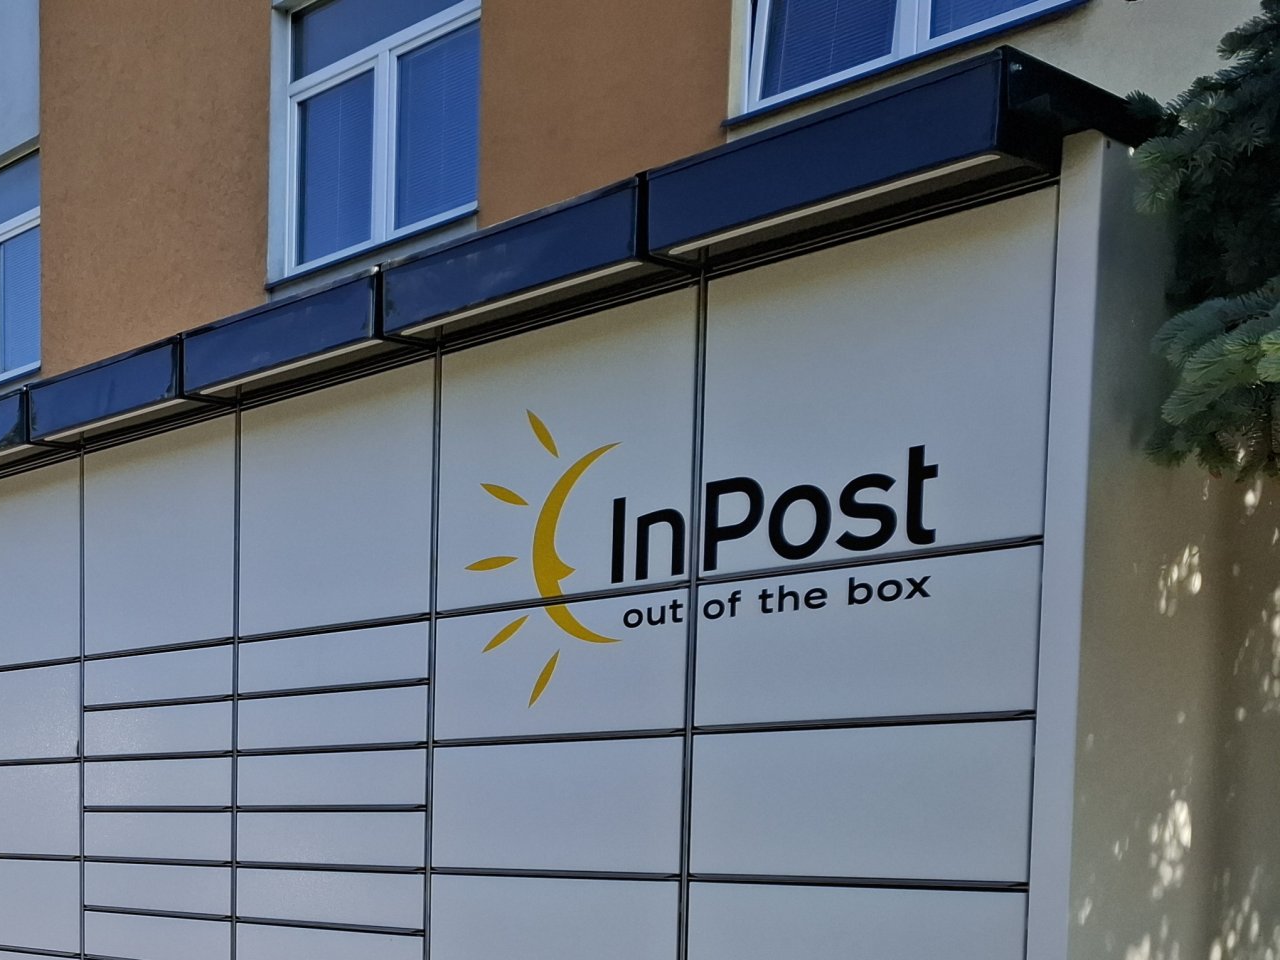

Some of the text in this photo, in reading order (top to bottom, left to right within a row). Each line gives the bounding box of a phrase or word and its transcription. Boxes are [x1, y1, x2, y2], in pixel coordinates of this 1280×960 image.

[610, 444, 939, 584] InPost
[622, 575, 932, 629] out of the box
